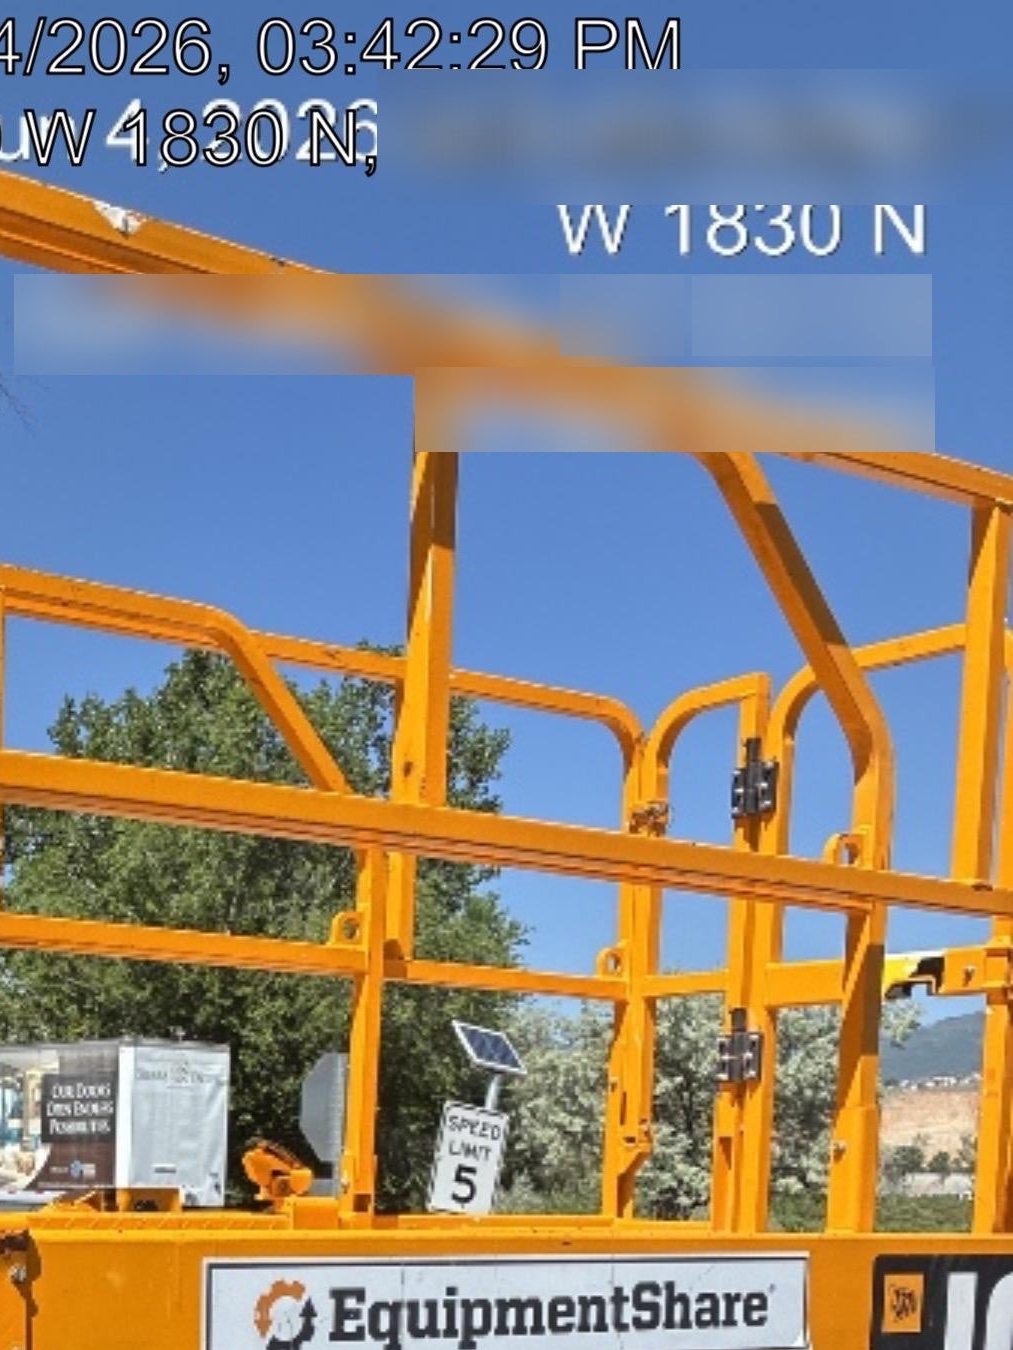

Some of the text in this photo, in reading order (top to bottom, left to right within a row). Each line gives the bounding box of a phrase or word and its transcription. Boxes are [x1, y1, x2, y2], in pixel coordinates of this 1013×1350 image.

[448, 1115, 501, 1141] SPEED
[449, 1140, 492, 1161] LIMIT
[451, 1163, 478, 1204] 5
